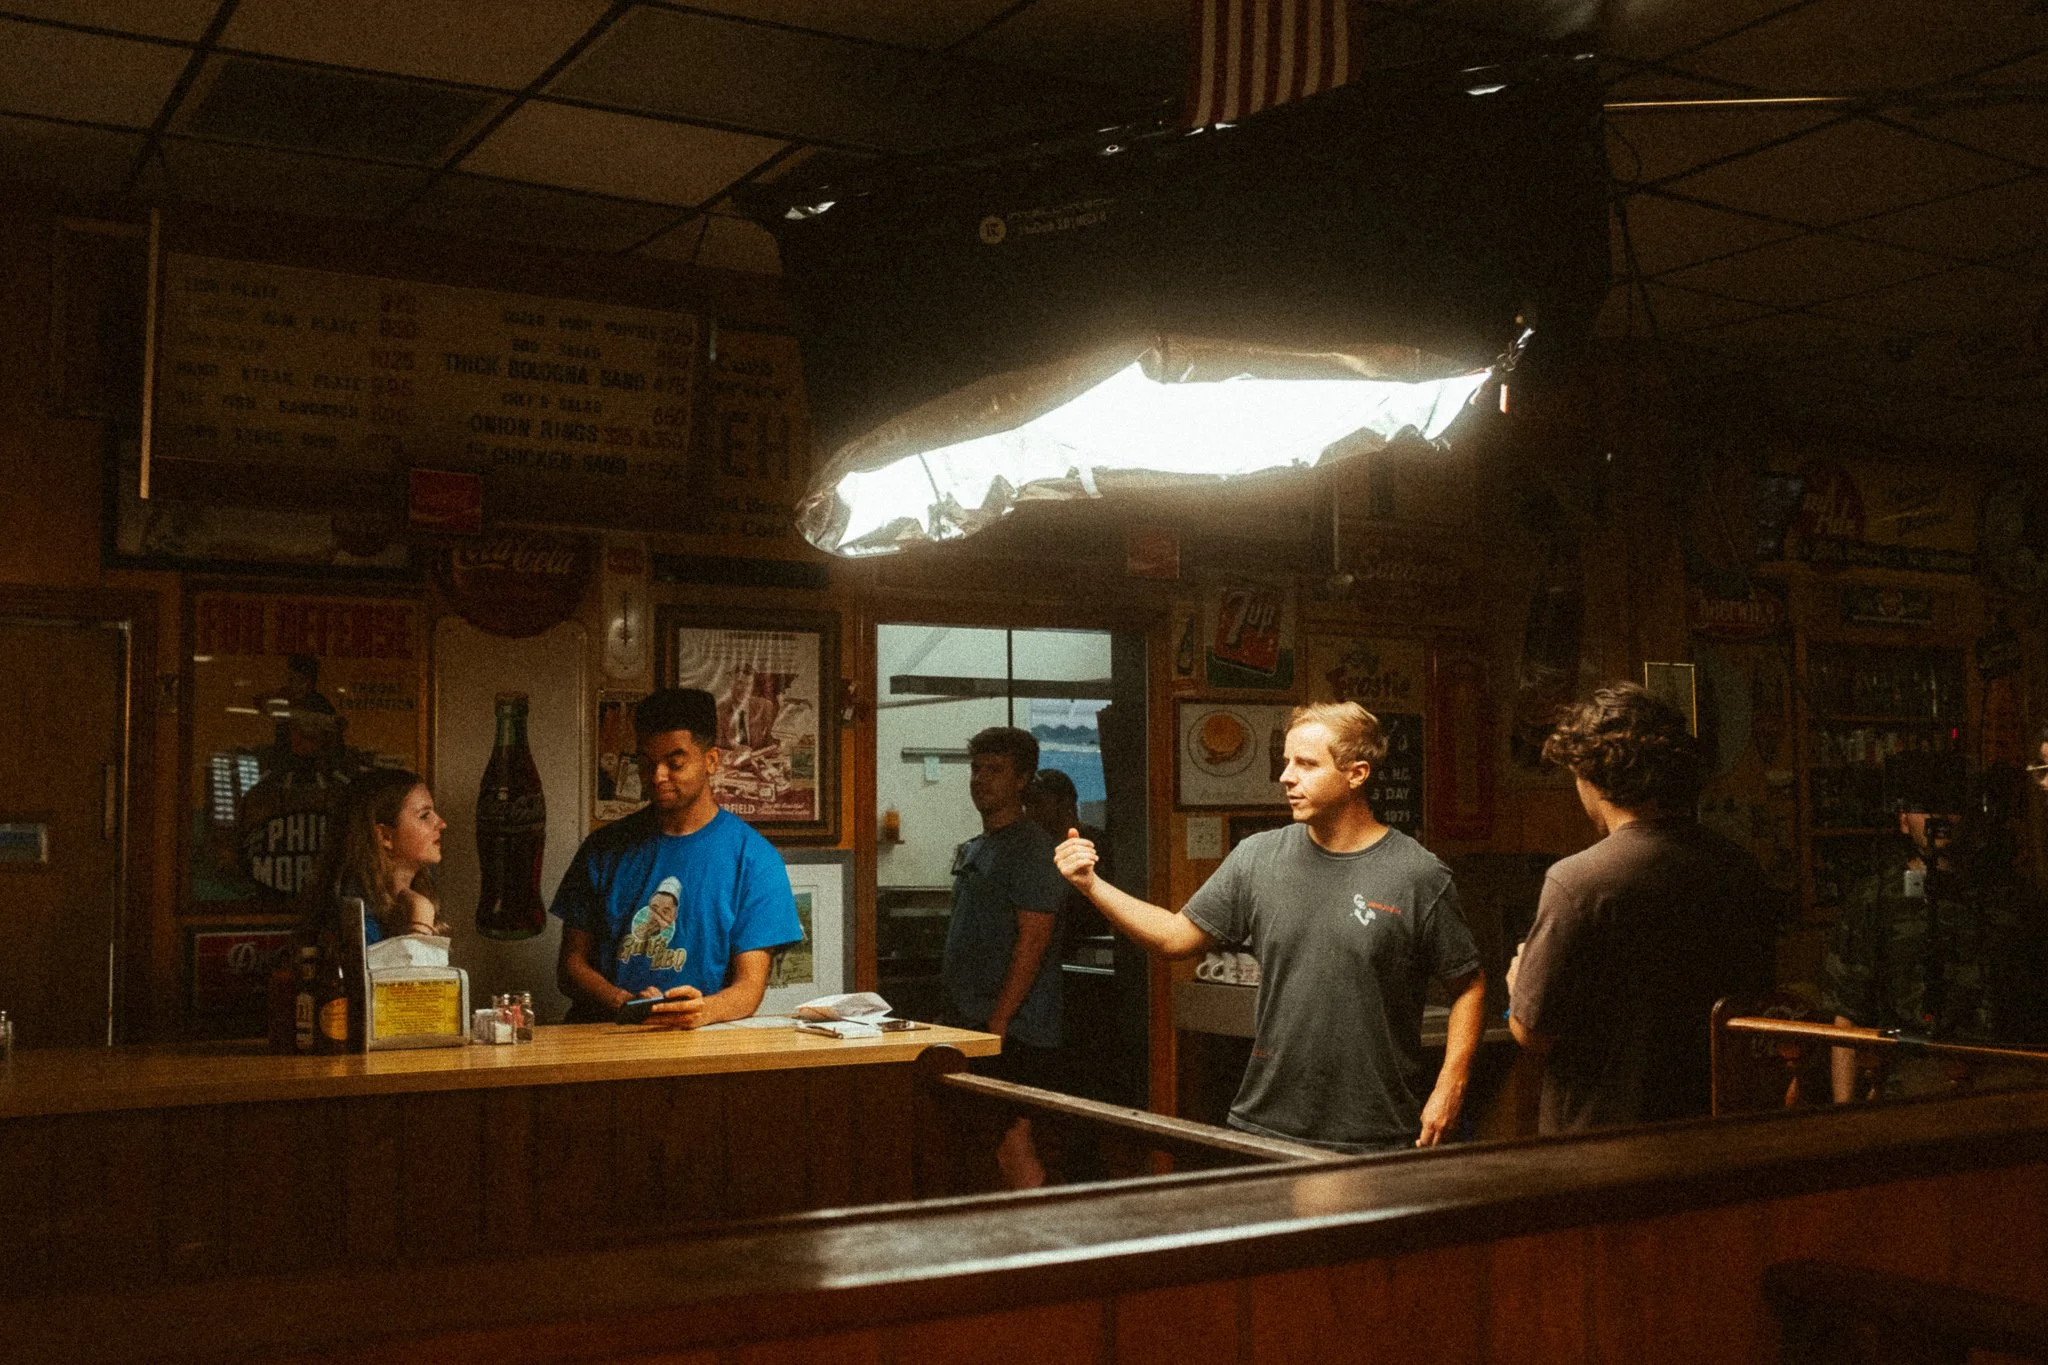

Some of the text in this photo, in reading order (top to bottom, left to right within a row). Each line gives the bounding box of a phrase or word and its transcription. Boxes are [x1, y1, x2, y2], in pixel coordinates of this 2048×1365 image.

[444, 352, 499, 376] THICK
[508, 359, 589, 385] BOLOGNA
[601, 367, 647, 391] SAND
[470, 413, 532, 437] ONION
[540, 419, 598, 443] RINGS
[201, 600, 413, 660] FOR DEFENSE
[1385, 786, 1411, 801] DAY
